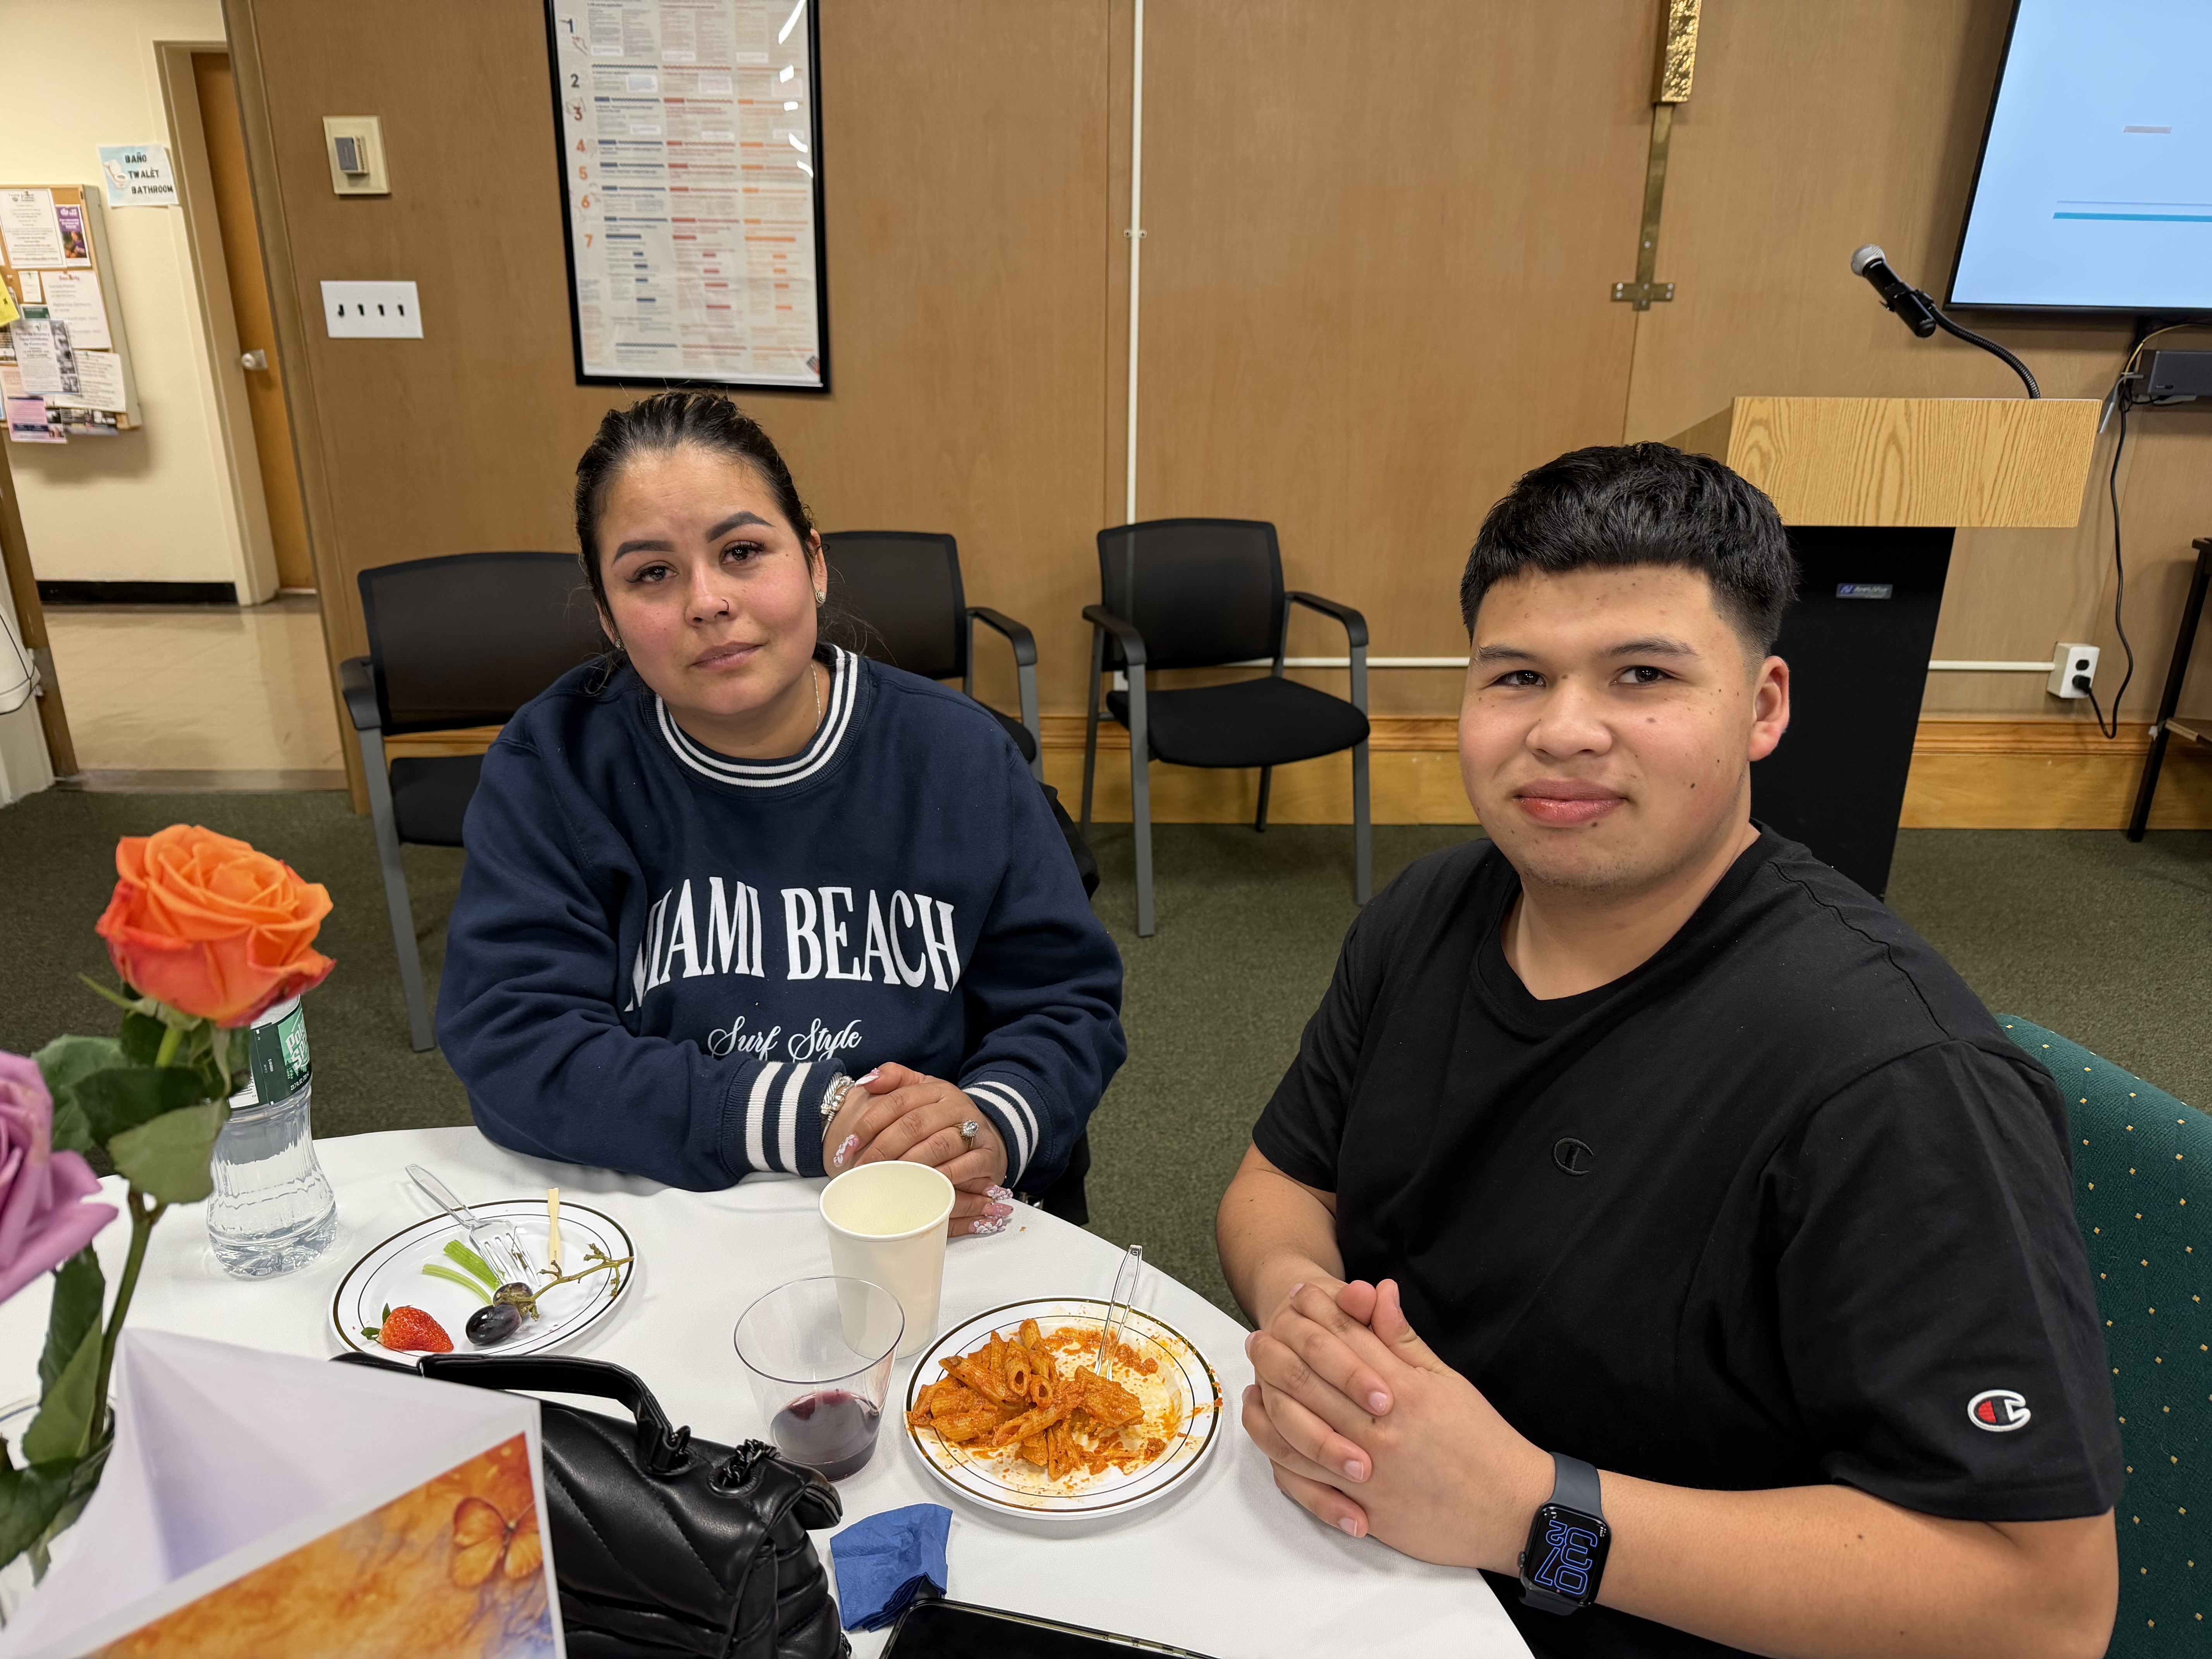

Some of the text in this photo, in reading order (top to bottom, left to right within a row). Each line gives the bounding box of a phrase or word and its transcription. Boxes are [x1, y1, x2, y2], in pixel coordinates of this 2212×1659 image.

[570, 73, 580, 88] 2
[574, 106, 583, 121] 3
[576, 138, 586, 153] 4
[125, 152, 147, 163] BAÑO
[579, 165, 588, 181] 5
[131, 185, 173, 194] BATHROOM
[581, 194, 591, 209] 6
[584, 233, 593, 249] 7
[781, 886, 960, 994] BEACH
[708, 1015, 862, 1063] Surf Style
